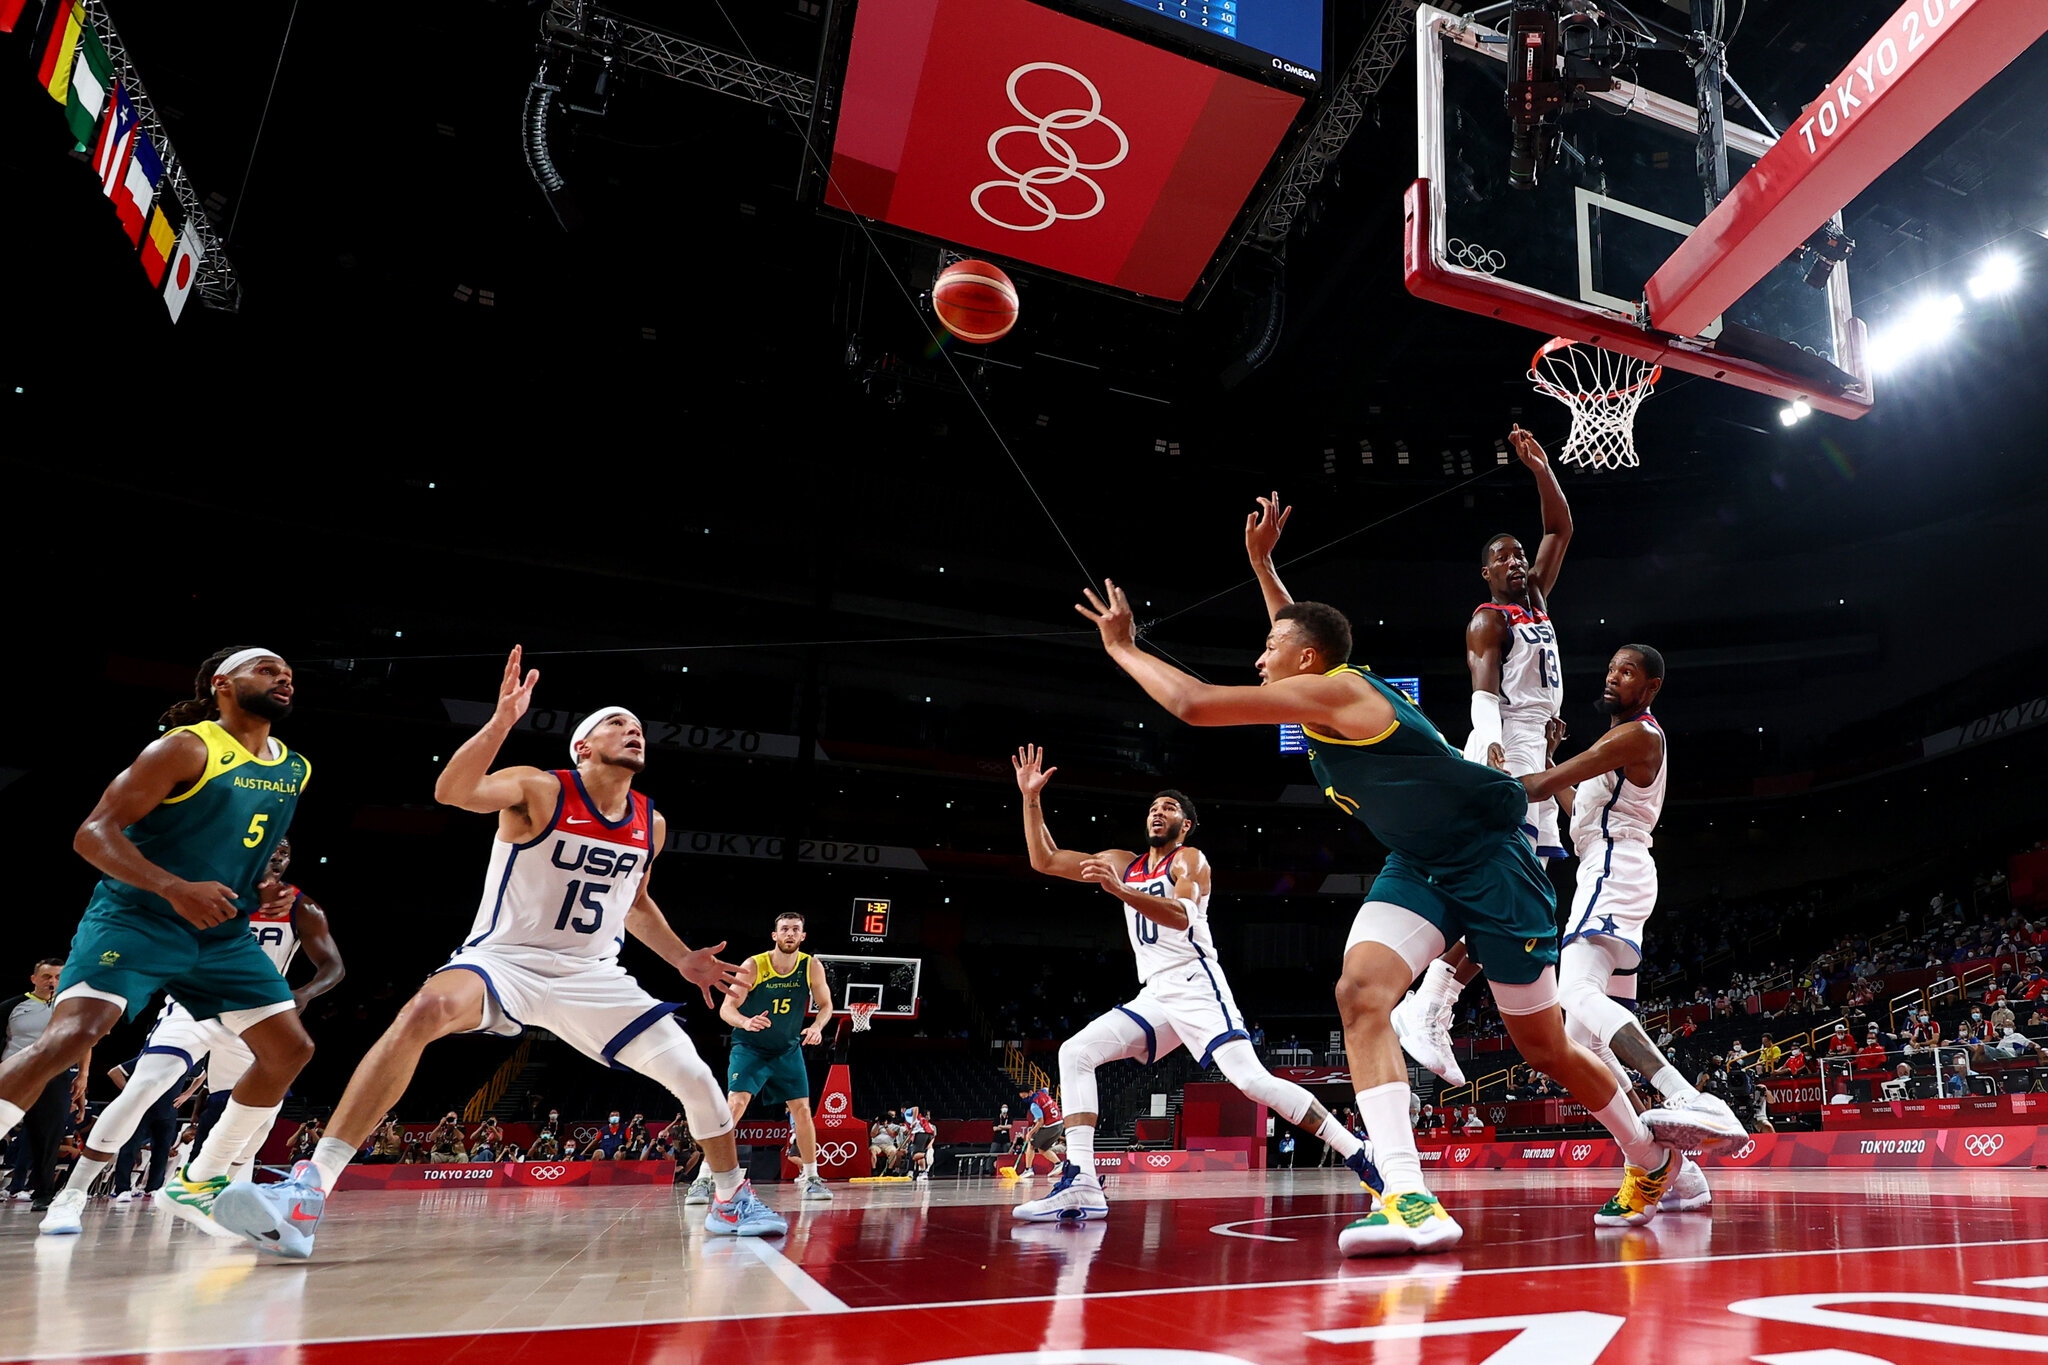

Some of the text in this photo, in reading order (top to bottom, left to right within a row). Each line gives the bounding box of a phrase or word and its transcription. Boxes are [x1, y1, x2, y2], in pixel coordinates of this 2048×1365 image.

[1224, 1, 1230, 10] 6
[1158, 2, 1229, 34] 1 0 2 4
[1202, 6, 1208, 15] 1
[1221, 12, 1232, 22] 10
[1283, 63, 1317, 82] OMEGA
[1799, 0, 1962, 154] TOKYO 20
[1539, 648, 1559, 689] 13
[659, 722, 760, 752] 2020
[233, 776, 297, 793] AUSTRALIA
[242, 813, 269, 848] 5
[669, 831, 880, 864] TOKYO 2020
[551, 839, 639, 879] USA
[554, 879, 612, 935] 15
[867, 902, 888, 914] 1:32
[864, 915, 884, 934] 16
[1135, 911, 1159, 947] 10
[765, 980, 799, 989] AUSTRALIA
[772, 998, 792, 1014] 15
[1773, 1087, 1821, 1104] KYO 2020
[1050, 1107, 1059, 1118] 5
[1559, 1104, 1581, 1117] TOKYO
[734, 1128, 788, 1139] OKYO 202
[1522, 1148, 1555, 1159] TOKYO 2020
[1860, 1139, 1926, 1154] TOKYO 2020
[1101, 1158, 1121, 1166] 2020
[1429, 1151, 1442, 1161] 2020
[424, 1169, 493, 1180] TOKYO 2020
